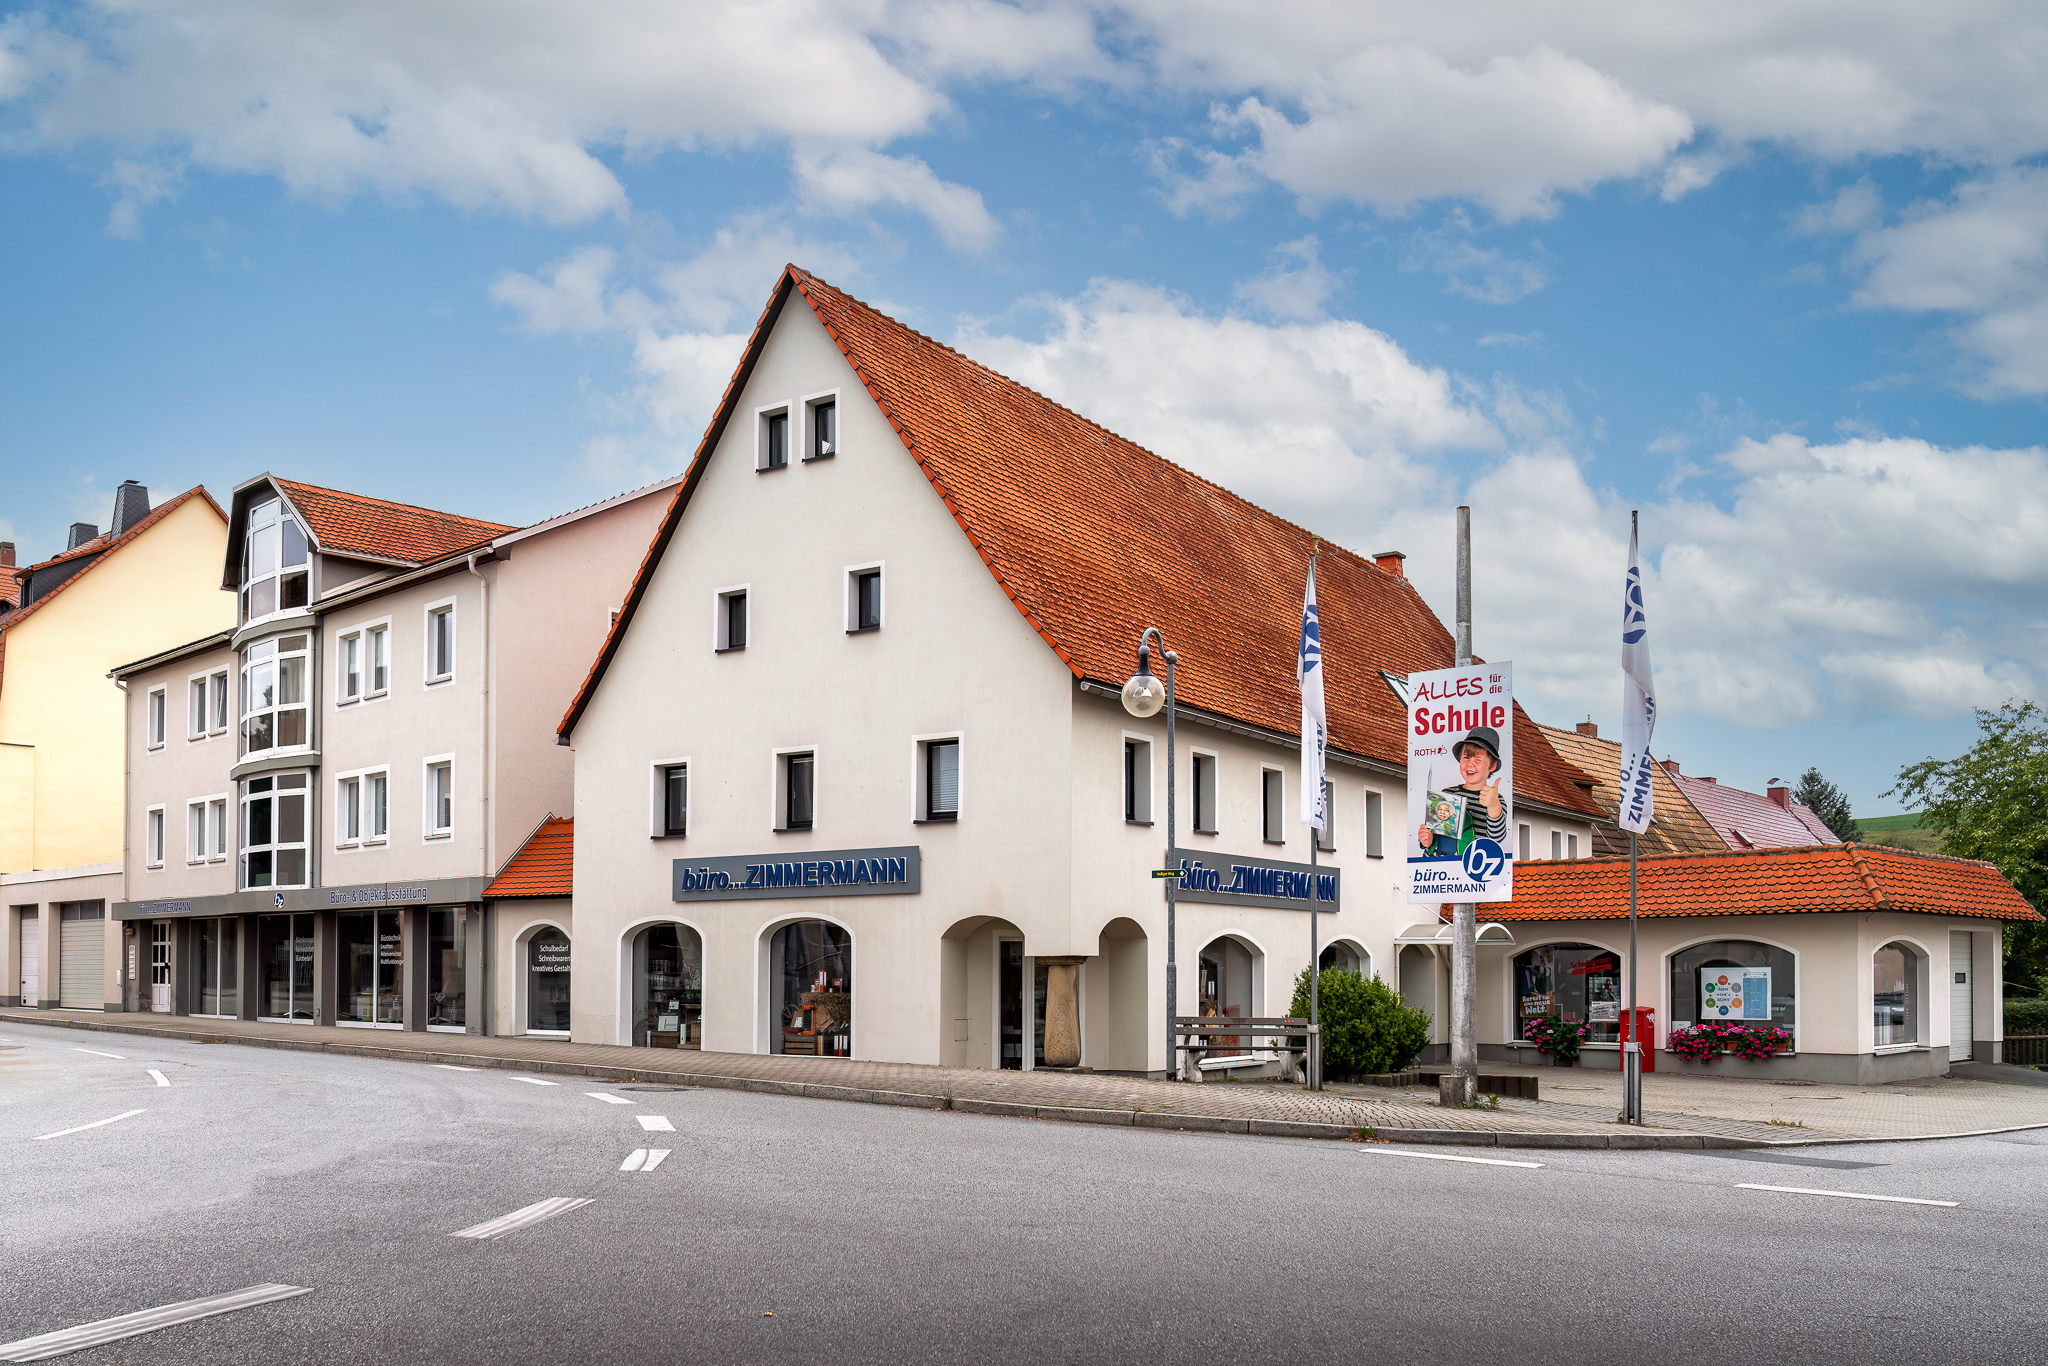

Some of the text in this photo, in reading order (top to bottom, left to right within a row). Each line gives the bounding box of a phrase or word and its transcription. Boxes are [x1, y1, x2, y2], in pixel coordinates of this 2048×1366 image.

[1489, 674, 1502, 683] für
[1414, 677, 1483, 702] ALLES
[1489, 685, 1502, 694] die
[1415, 701, 1505, 736] Schule
[1415, 748, 1437, 757] ROTH
[1413, 869, 1460, 882] büro...
[1413, 883, 1486, 894] ZIMMERMANN
[330, 887, 427, 905] Büro- & Objektausstattung
[1570, 957, 1611, 969] Schulranzen
[1522, 994, 1542, 1002] Bereit
[1525, 1005, 1547, 1015] Welt.
